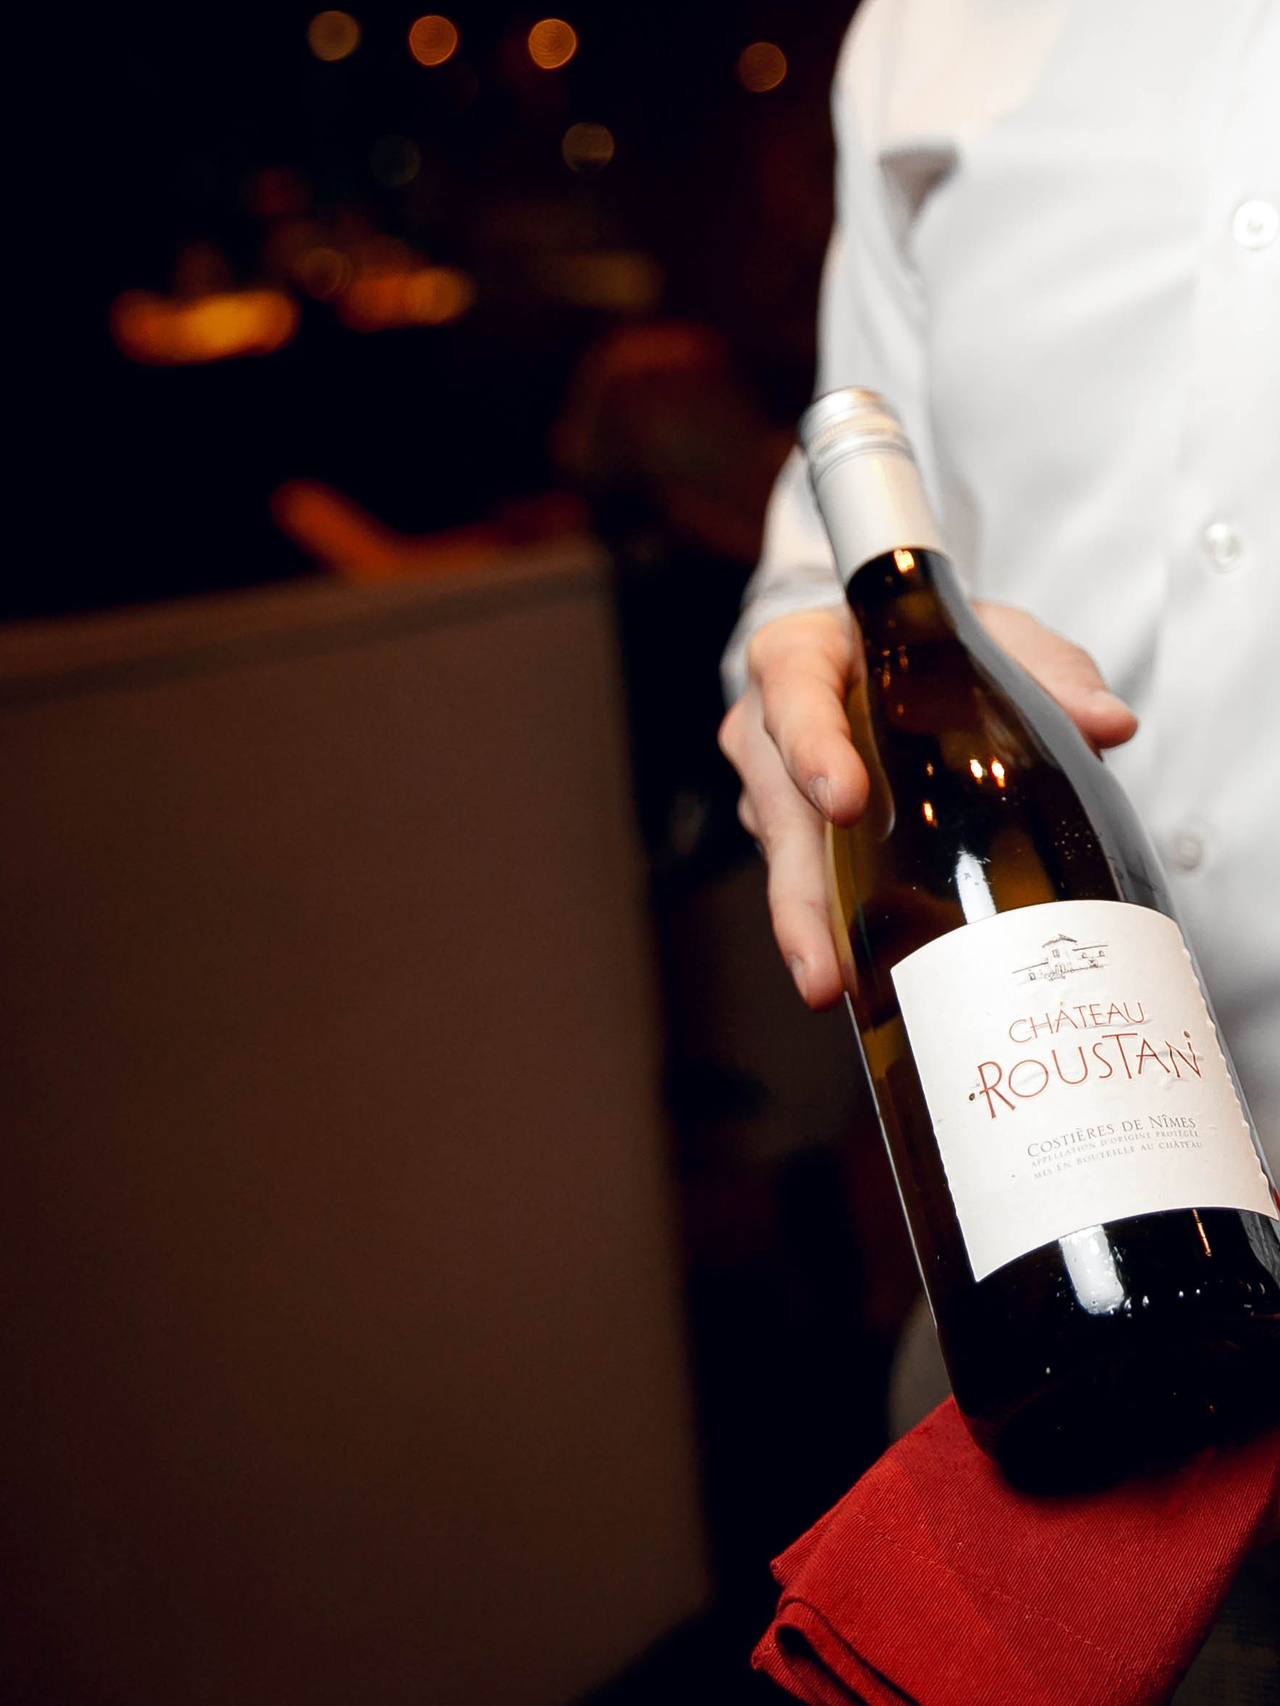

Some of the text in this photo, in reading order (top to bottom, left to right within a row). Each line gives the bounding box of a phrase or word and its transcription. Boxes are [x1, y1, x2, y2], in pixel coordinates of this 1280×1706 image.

[977, 1032, 1202, 1119] ROUSTAN
[1027, 1113, 1196, 1158] COSTIÈRES DE NÎMES
[1057, 1161, 1071, 1171] EN
[1076, 1145, 1136, 1165] BOUTEILLE
[1140, 1143, 1154, 1151] AU
